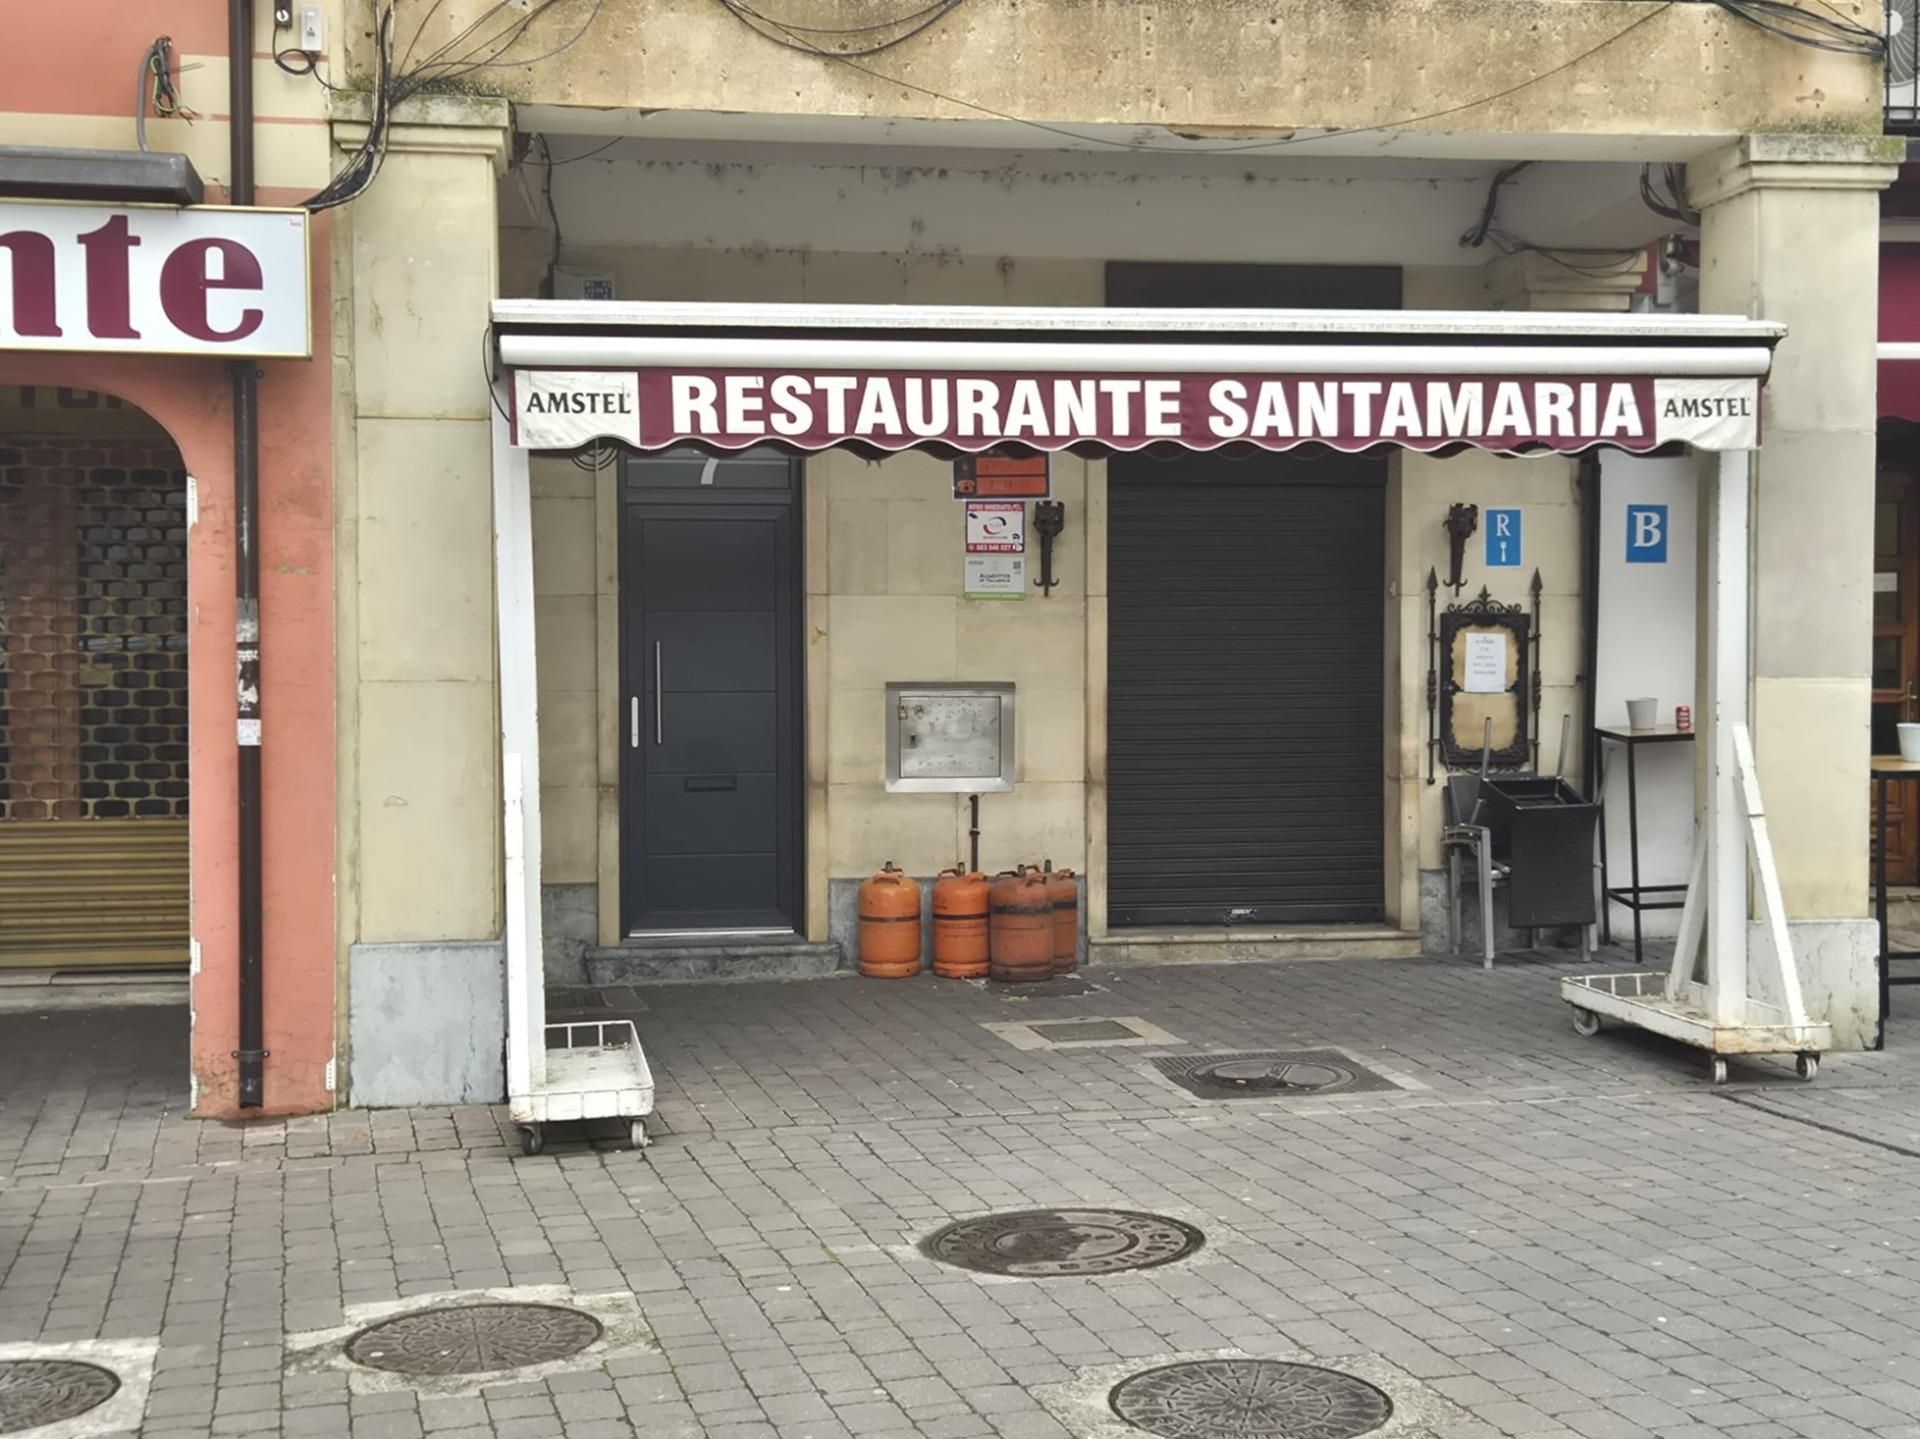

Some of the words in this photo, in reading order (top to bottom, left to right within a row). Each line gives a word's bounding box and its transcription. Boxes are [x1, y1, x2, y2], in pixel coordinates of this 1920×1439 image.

[526, 392, 632, 414] AMSTEL
[671, 375, 1182, 437] RESTAURANTE
[1208, 379, 1644, 438] SANTAMARIA
[1664, 397, 1751, 418] AMSTEL
[1495, 513, 1511, 537] R
[1632, 511, 1661, 548] B
